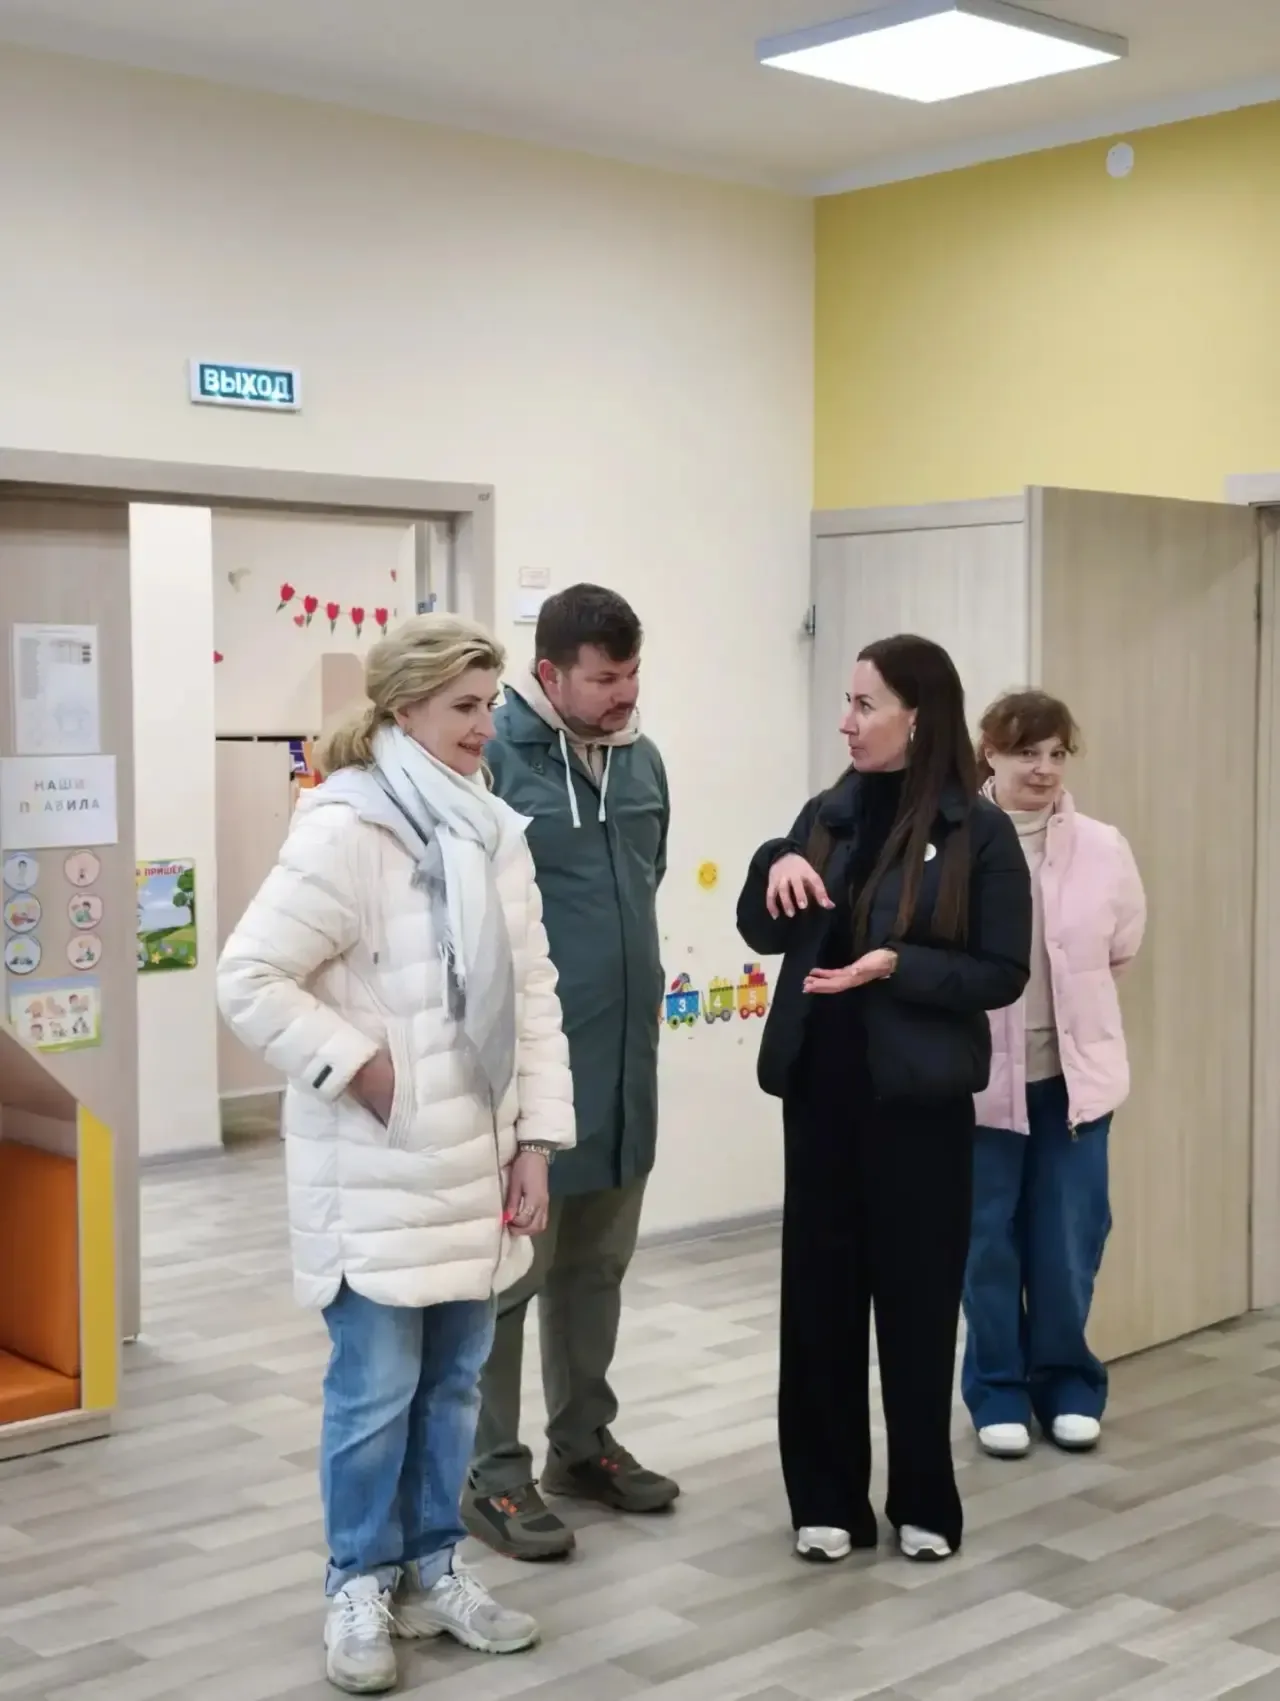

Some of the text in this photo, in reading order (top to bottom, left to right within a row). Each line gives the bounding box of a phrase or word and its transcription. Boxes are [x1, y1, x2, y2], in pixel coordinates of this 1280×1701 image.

[203, 368, 291, 400] ВЫХОД
[34, 779, 86, 791] НАШИ
[19, 798, 100, 813] ПАВИЛА
[678, 991, 757, 1012] 3 4 5
